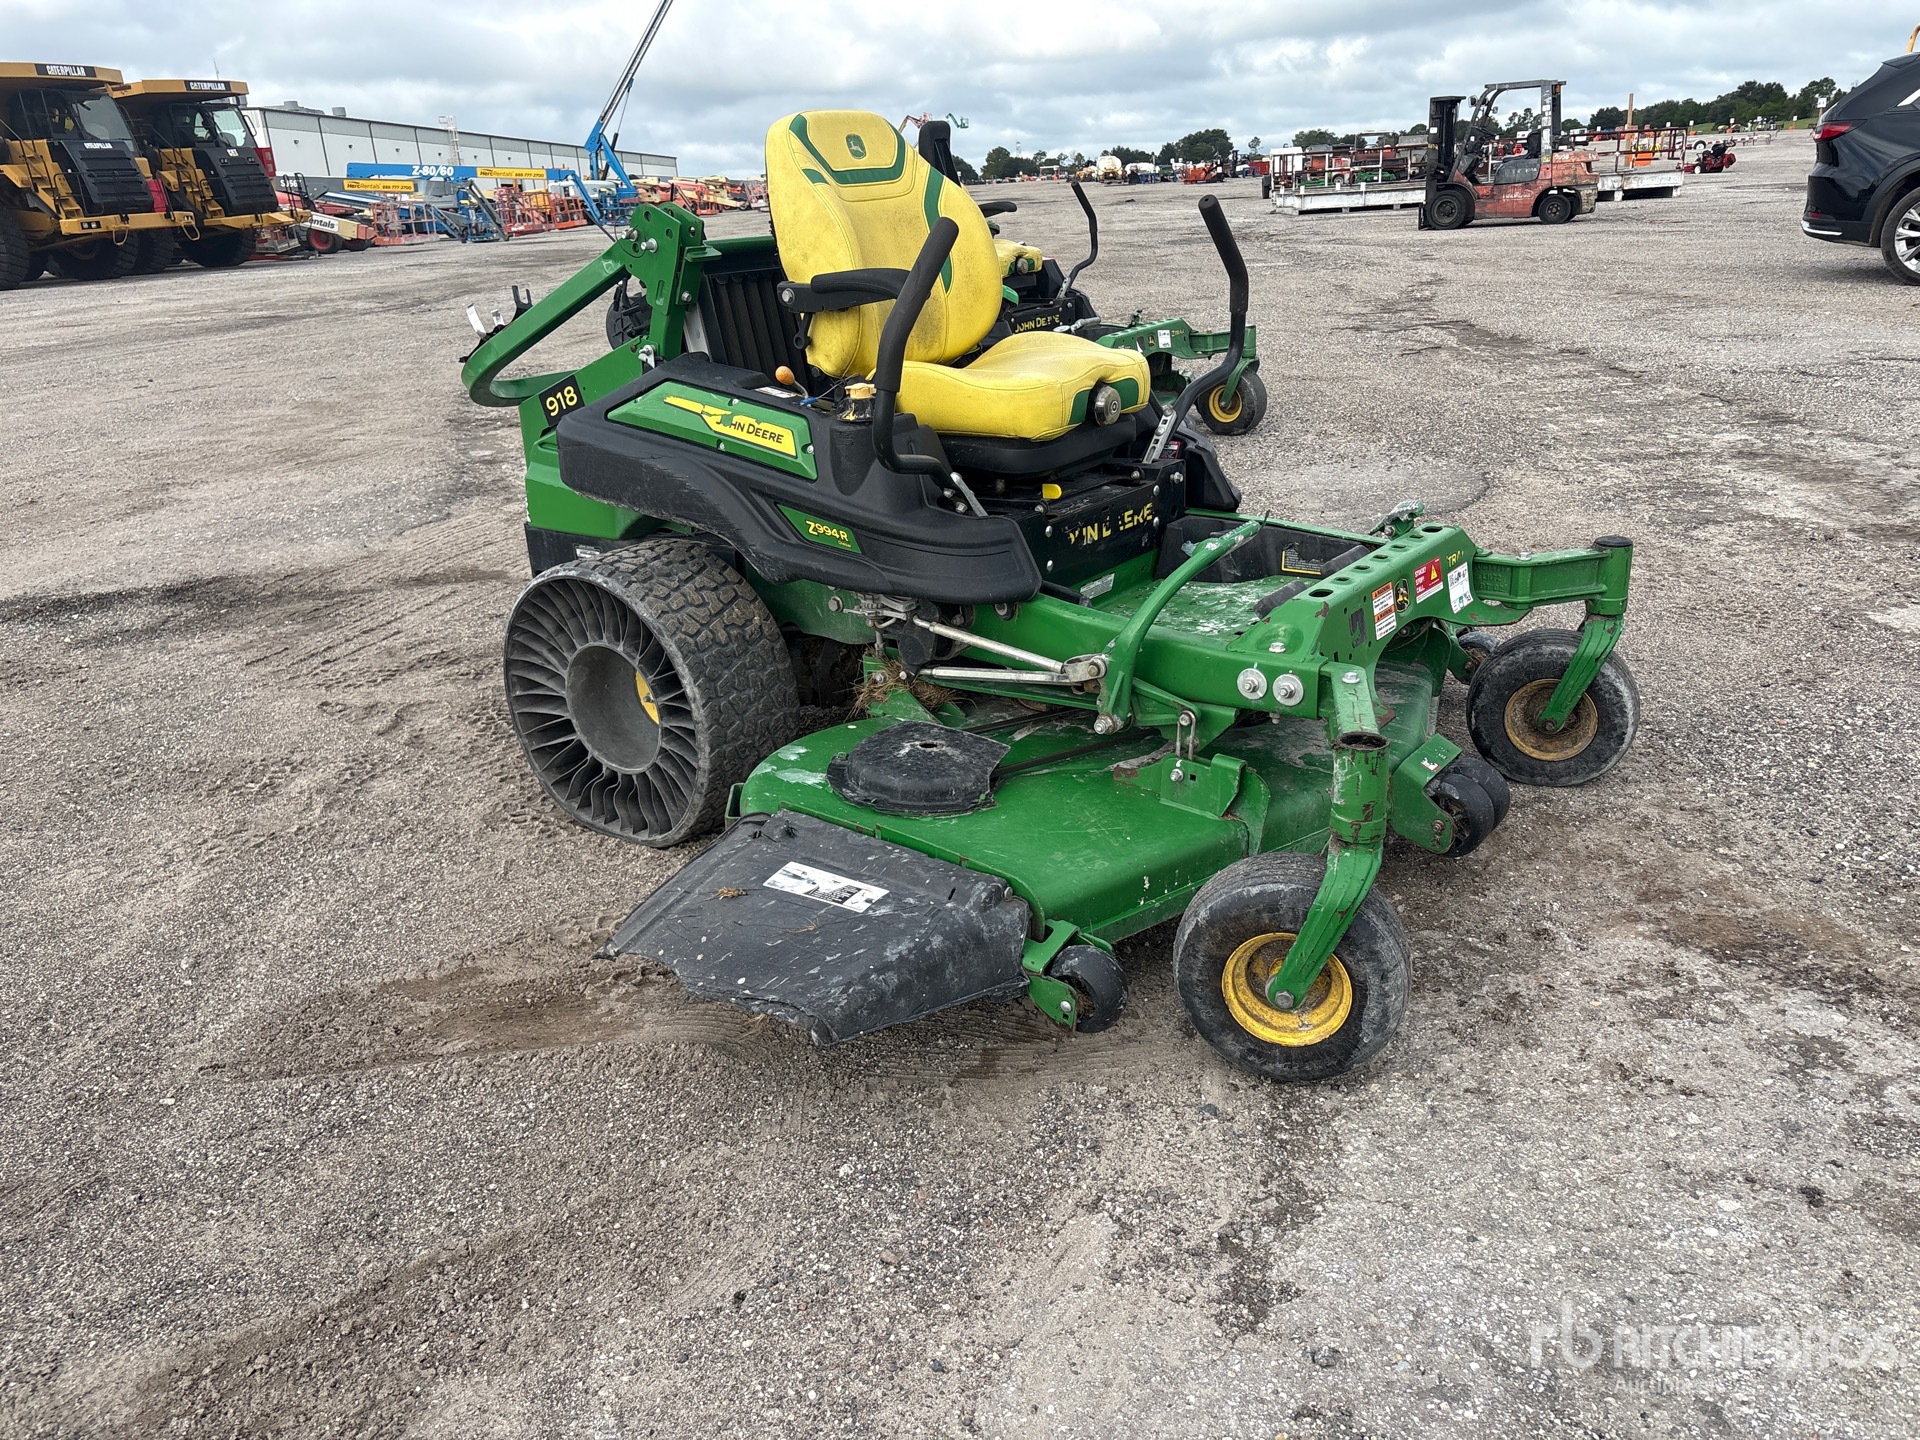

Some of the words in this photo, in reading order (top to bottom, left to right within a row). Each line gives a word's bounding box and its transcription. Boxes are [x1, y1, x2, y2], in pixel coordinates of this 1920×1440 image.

[46, 65, 86, 76] CATERPILLAR
[190, 82, 225, 90] CATERPILLAR
[412, 165, 454, 176] Z-80/60
[1015, 320, 1035, 333] JOHN
[546, 386, 577, 417] 918
[746, 423, 784, 444] DEERE
[805, 520, 849, 541] Z994R
